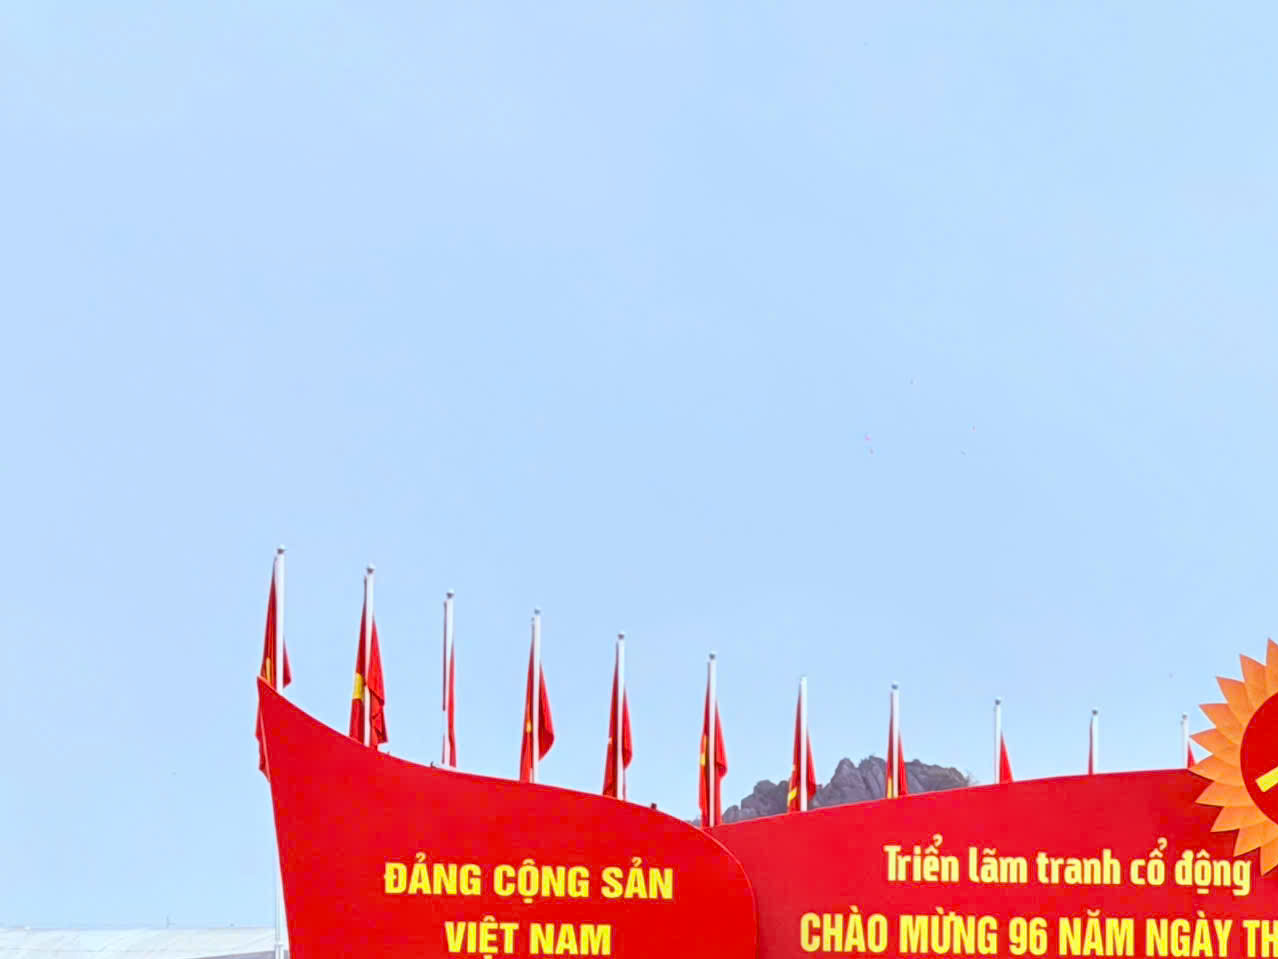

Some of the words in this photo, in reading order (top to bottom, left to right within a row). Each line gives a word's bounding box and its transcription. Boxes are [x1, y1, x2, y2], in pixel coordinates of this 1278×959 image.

[383, 851, 482, 896] ĐẢNG
[493, 858, 590, 904] CỘNG
[601, 856, 674, 900] SẢN
[883, 833, 960, 883] Triển
[968, 846, 1028, 884] lãm
[1035, 848, 1121, 885] tranh
[1129, 837, 1168, 886] cổ
[1174, 850, 1252, 897] động
[529, 922, 612, 956] NAM
[800, 905, 889, 953] CHÀO
[899, 906, 998, 956] MỪNG
[1008, 916, 1048, 956] 96
[1058, 909, 1135, 957] NĂM
[1145, 910, 1233, 958] NGÀY
